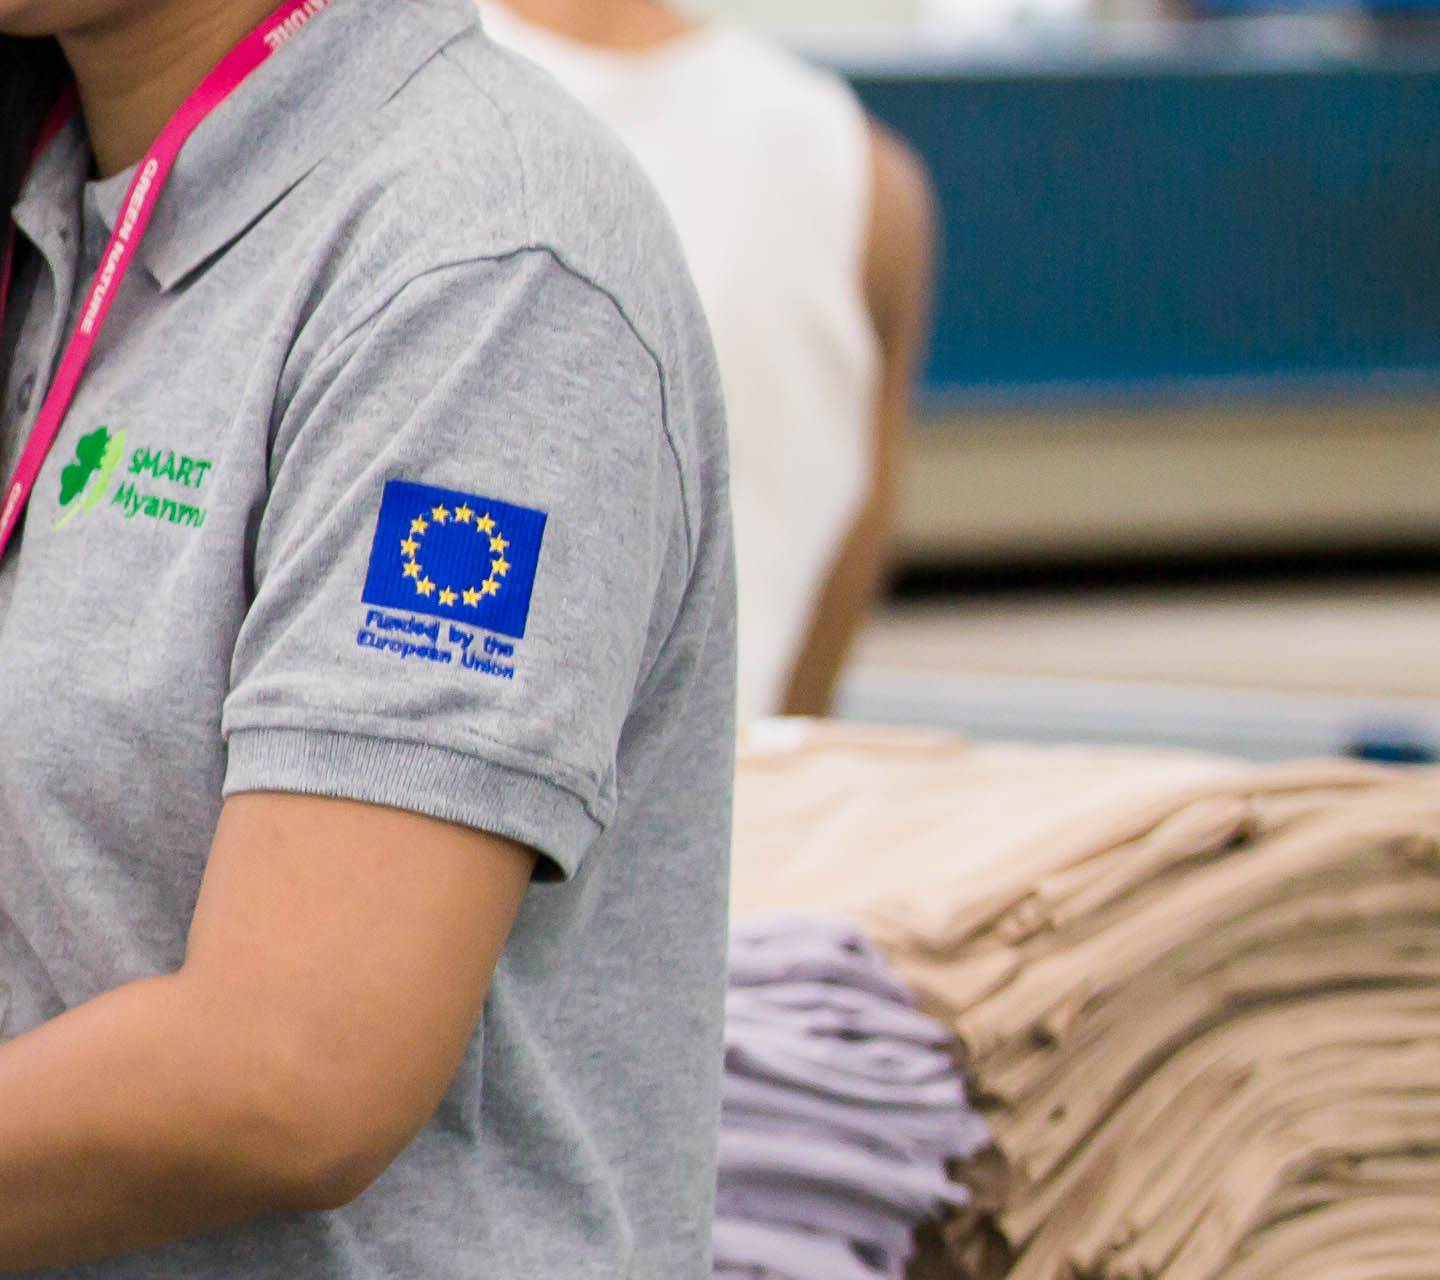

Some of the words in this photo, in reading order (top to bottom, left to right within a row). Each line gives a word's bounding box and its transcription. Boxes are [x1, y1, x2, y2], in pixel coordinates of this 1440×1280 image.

[119, 159, 158, 241] GREEN
[81, 240, 125, 334] NATURE
[127, 447, 211, 488] SMART
[357, 629, 452, 664] European
[461, 650, 514, 680] Union
[366, 610, 440, 647] Funded
[449, 624, 474, 650] by
[483, 636, 514, 658] the
